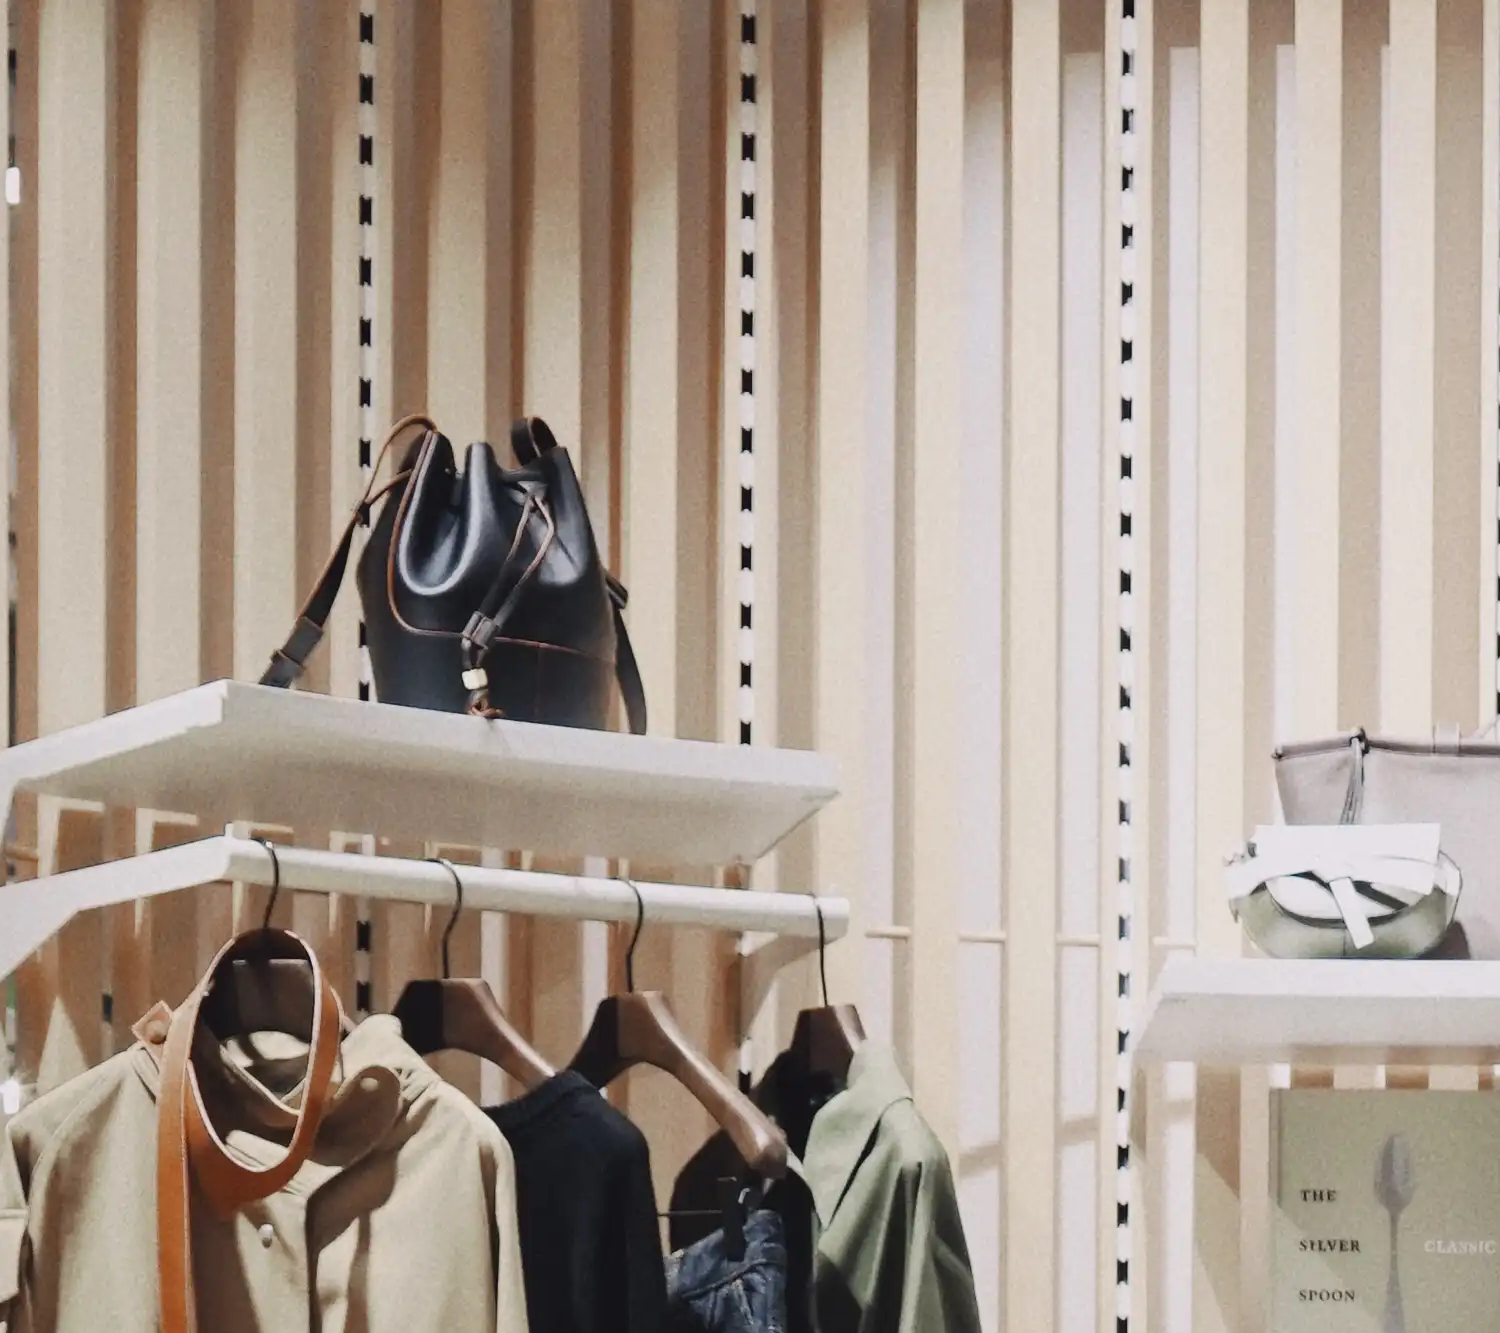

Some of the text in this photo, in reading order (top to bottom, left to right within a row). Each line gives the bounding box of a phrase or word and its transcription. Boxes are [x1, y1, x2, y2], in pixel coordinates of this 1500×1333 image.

[1300, 1189, 1337, 1202] THE
[1299, 1239, 1361, 1253] SILVER
[1424, 1239, 1498, 1255] CLASSIC
[1299, 1289, 1356, 1302] SPOON
